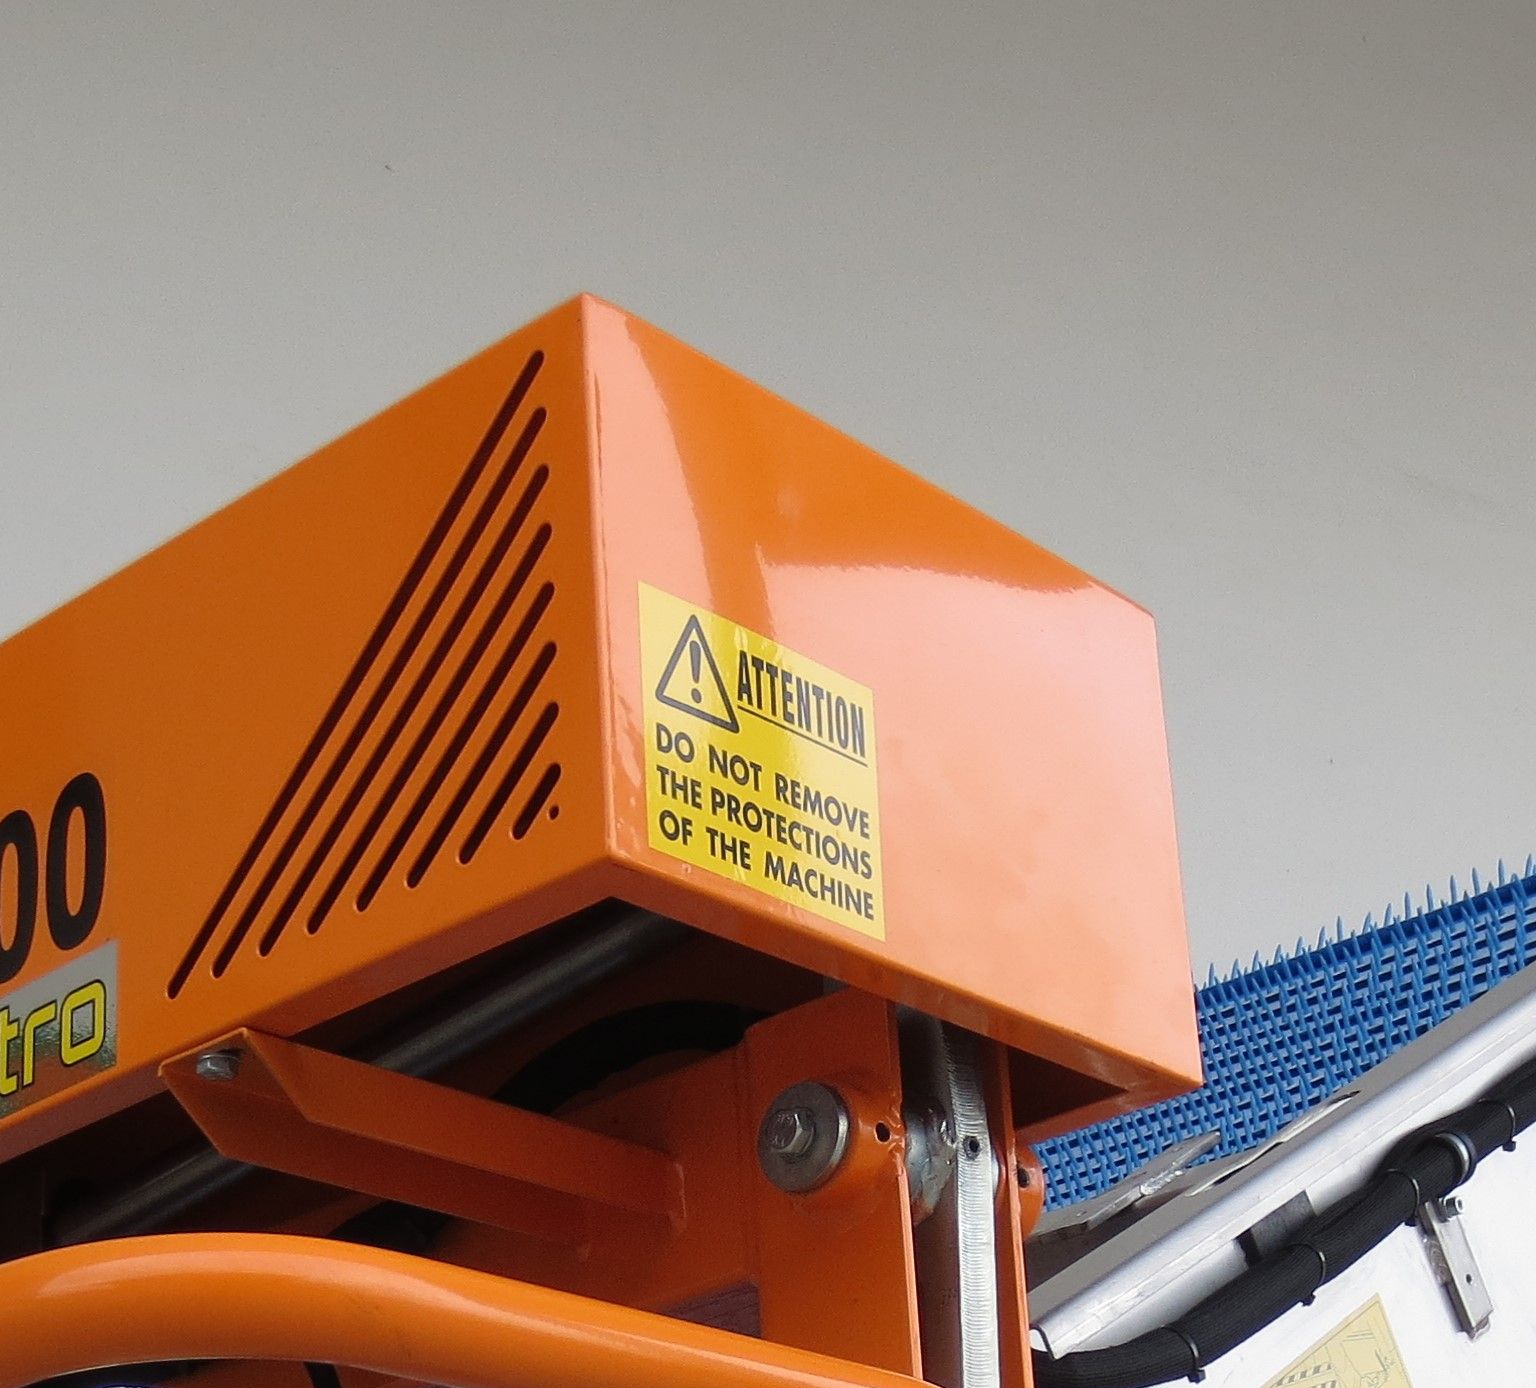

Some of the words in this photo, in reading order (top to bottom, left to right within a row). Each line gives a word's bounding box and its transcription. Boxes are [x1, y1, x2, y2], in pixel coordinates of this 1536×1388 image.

[737, 650, 866, 759] ATTENTION
[655, 723, 695, 763] DO
[708, 744, 763, 791] NOT
[775, 772, 870, 840] REMOVE
[655, 766, 703, 810] THE
[711, 787, 872, 880] PROTECTIONS
[658, 809, 694, 846] OF
[706, 826, 752, 871] THE
[764, 851, 874, 921] MACHINE
